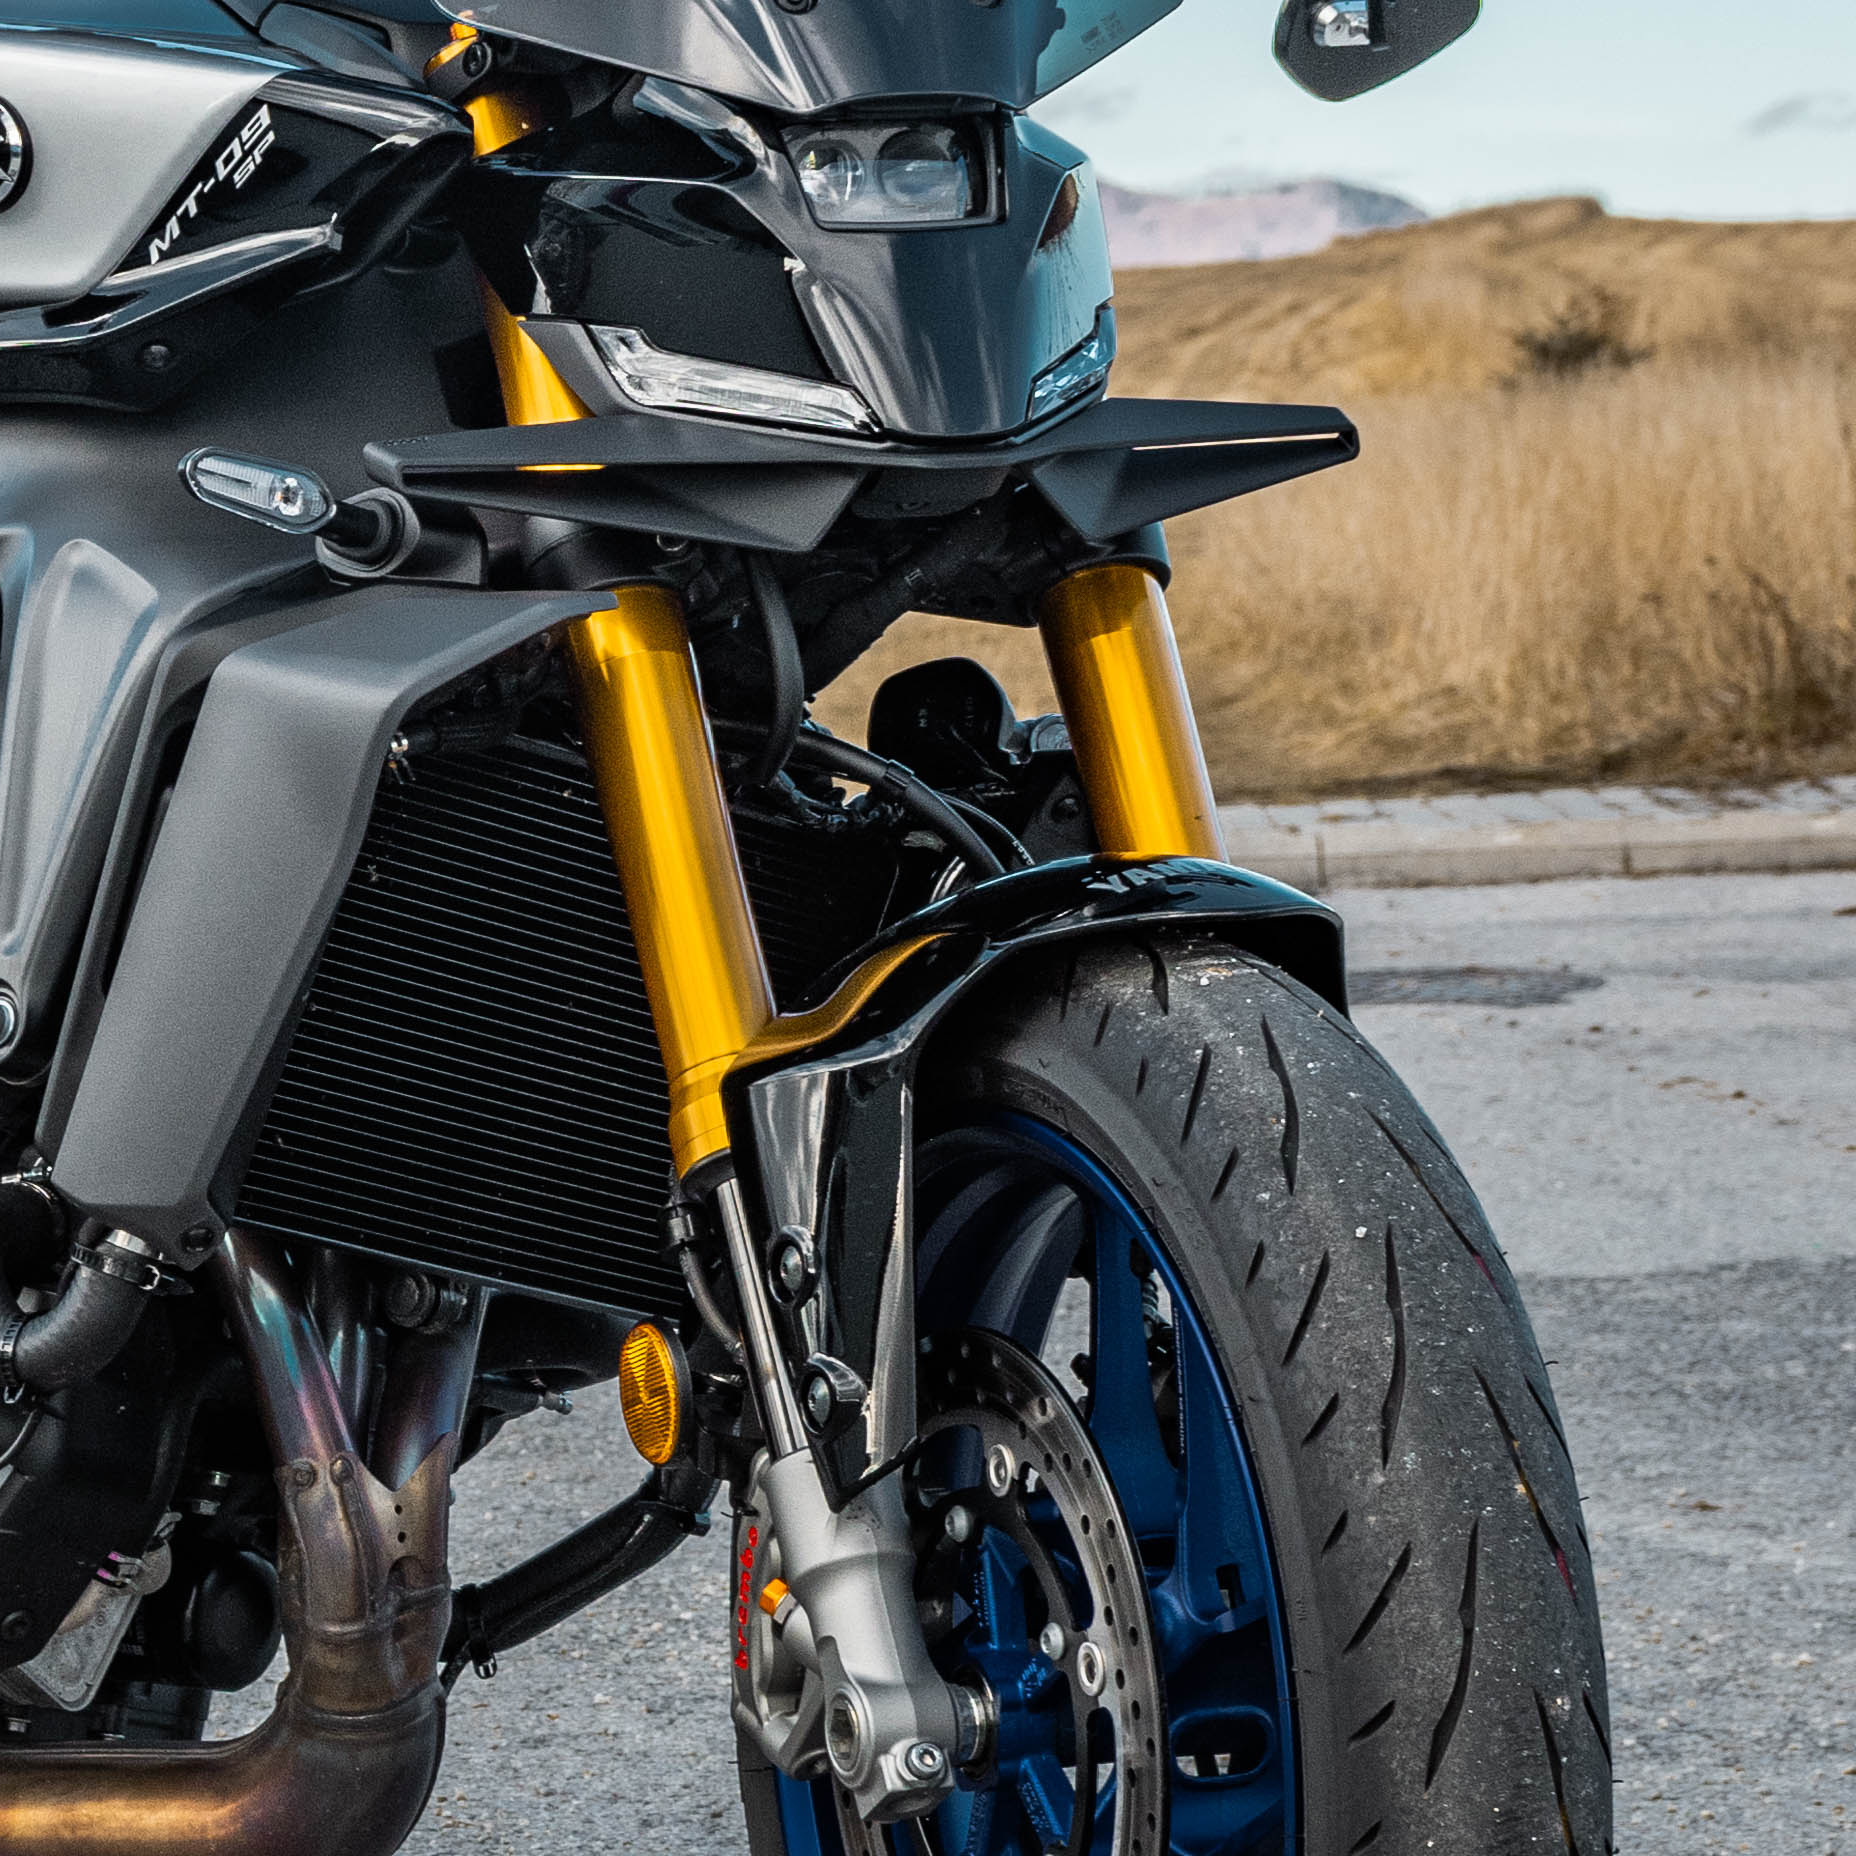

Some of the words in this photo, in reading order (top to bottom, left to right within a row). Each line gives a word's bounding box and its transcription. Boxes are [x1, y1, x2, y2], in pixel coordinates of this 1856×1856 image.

[149, 103, 271, 265] MT-09
[233, 129, 276, 189] SP
[734, 1525, 759, 1671] brembo
